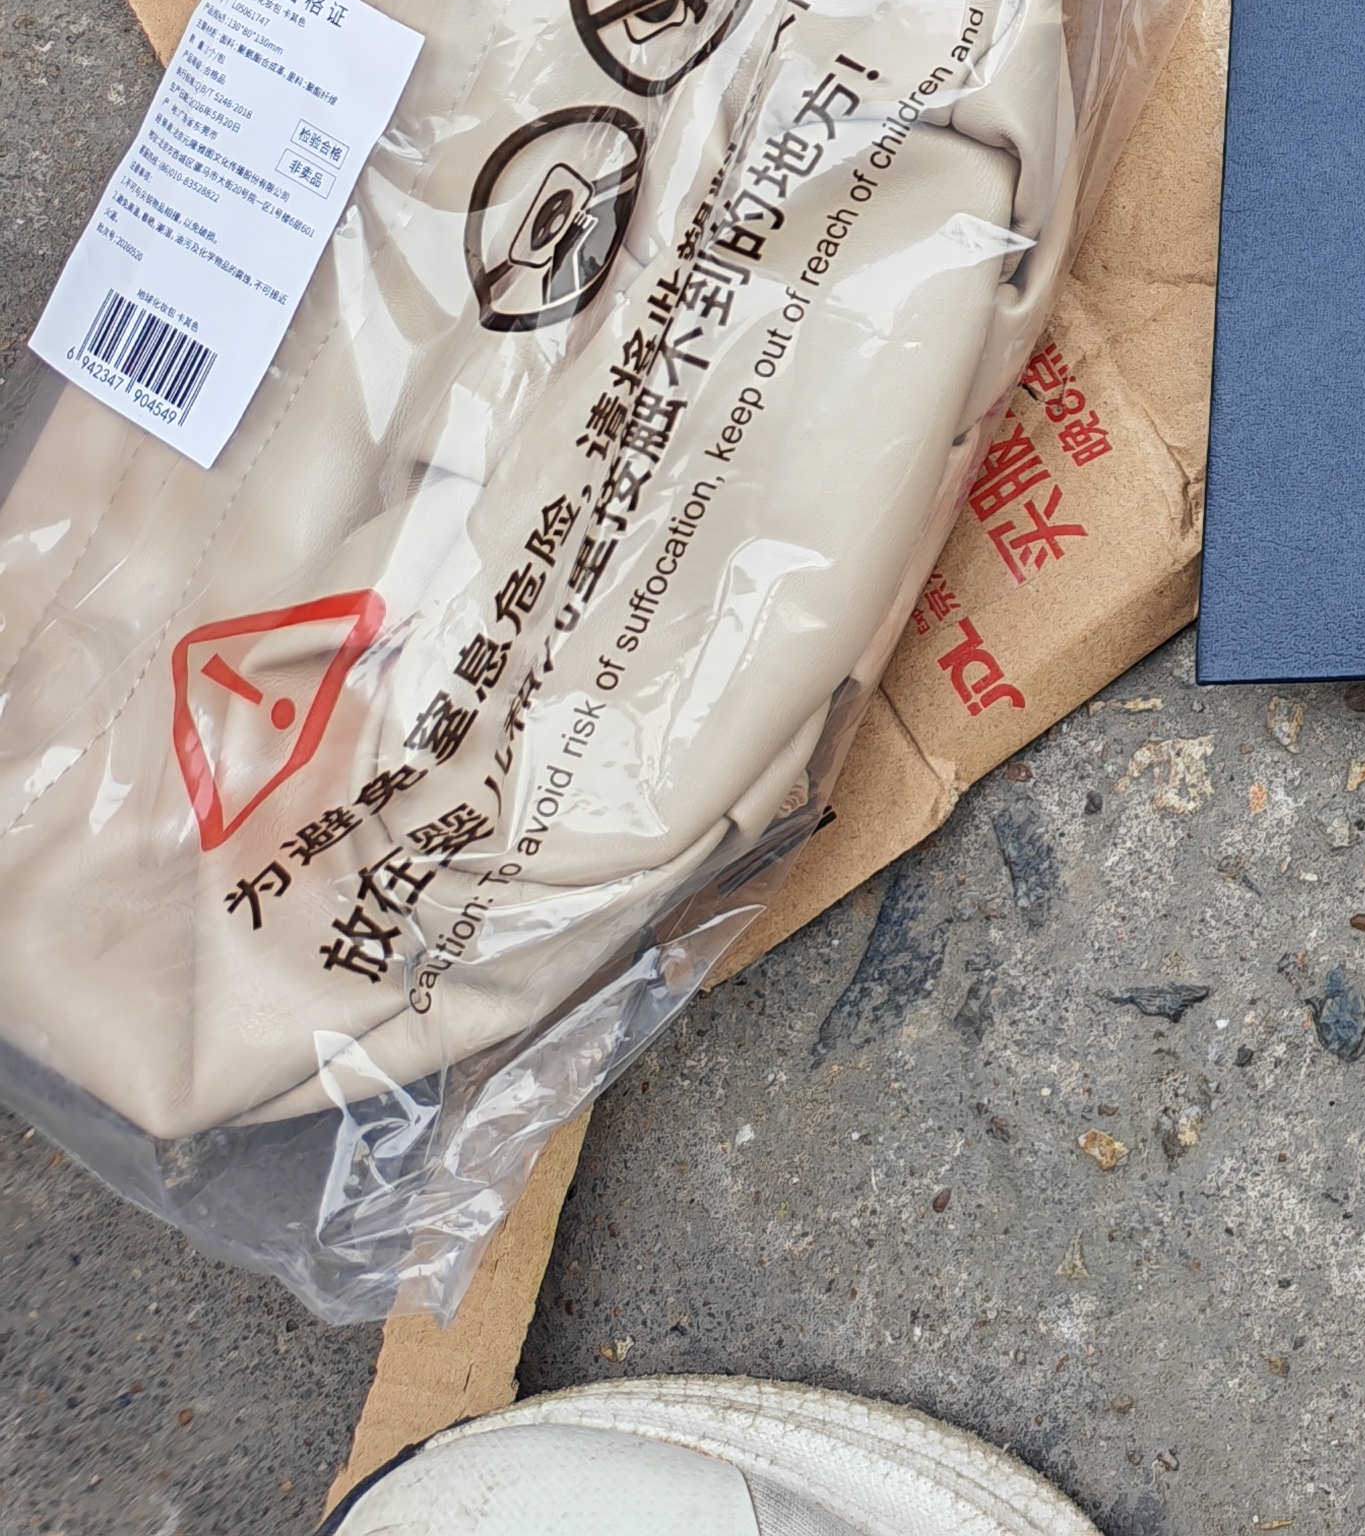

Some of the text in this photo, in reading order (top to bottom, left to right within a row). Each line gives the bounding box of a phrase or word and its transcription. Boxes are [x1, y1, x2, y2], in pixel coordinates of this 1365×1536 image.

[943, 0, 991, 65] and
[296, 125, 345, 163] 检验合格
[858, 52, 956, 174] children
[286, 157, 326, 189] 非卖品
[839, 164, 880, 208] of
[791, 197, 862, 292] reach
[134, 287, 201, 334] 地球化妆包 卡其色
[772, 284, 811, 327] of
[65, 345, 178, 425] 6 942347 904549
[746, 321, 793, 383] out
[702, 376, 770, 470] keep
[964, 410, 1087, 584] 买服
[603, 464, 730, 656] suffocation,
[586, 649, 626, 696] of
[553, 690, 608, 762] risk
[505, 758, 579, 861] avoid
[479, 850, 526, 896] To
[399, 882, 498, 1020] Caution:
